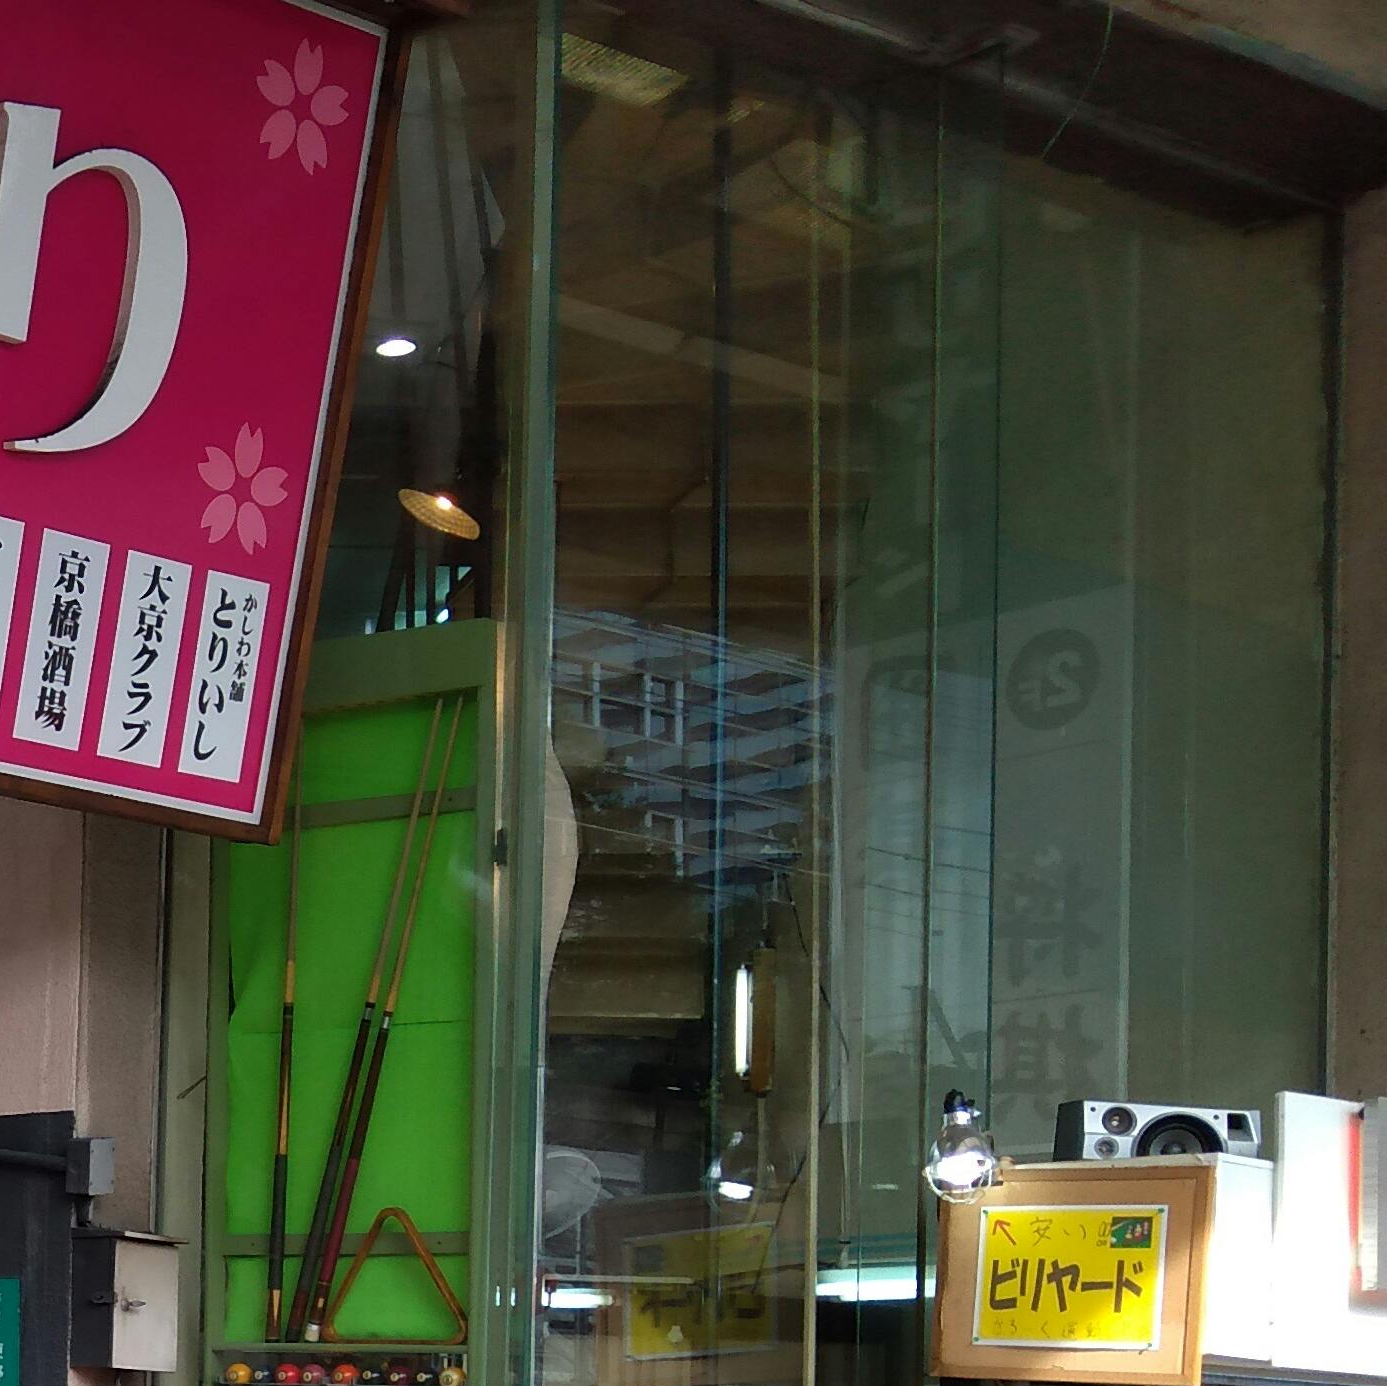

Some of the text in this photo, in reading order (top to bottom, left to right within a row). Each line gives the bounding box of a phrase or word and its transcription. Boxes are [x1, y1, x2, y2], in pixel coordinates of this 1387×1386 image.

[35, 550, 90, 731] 京橋酒場
[119, 565, 172, 751] 大京クラブ
[194, 588, 238, 760] とりいし
[990, 1258, 1144, 1313] ビリヤード
